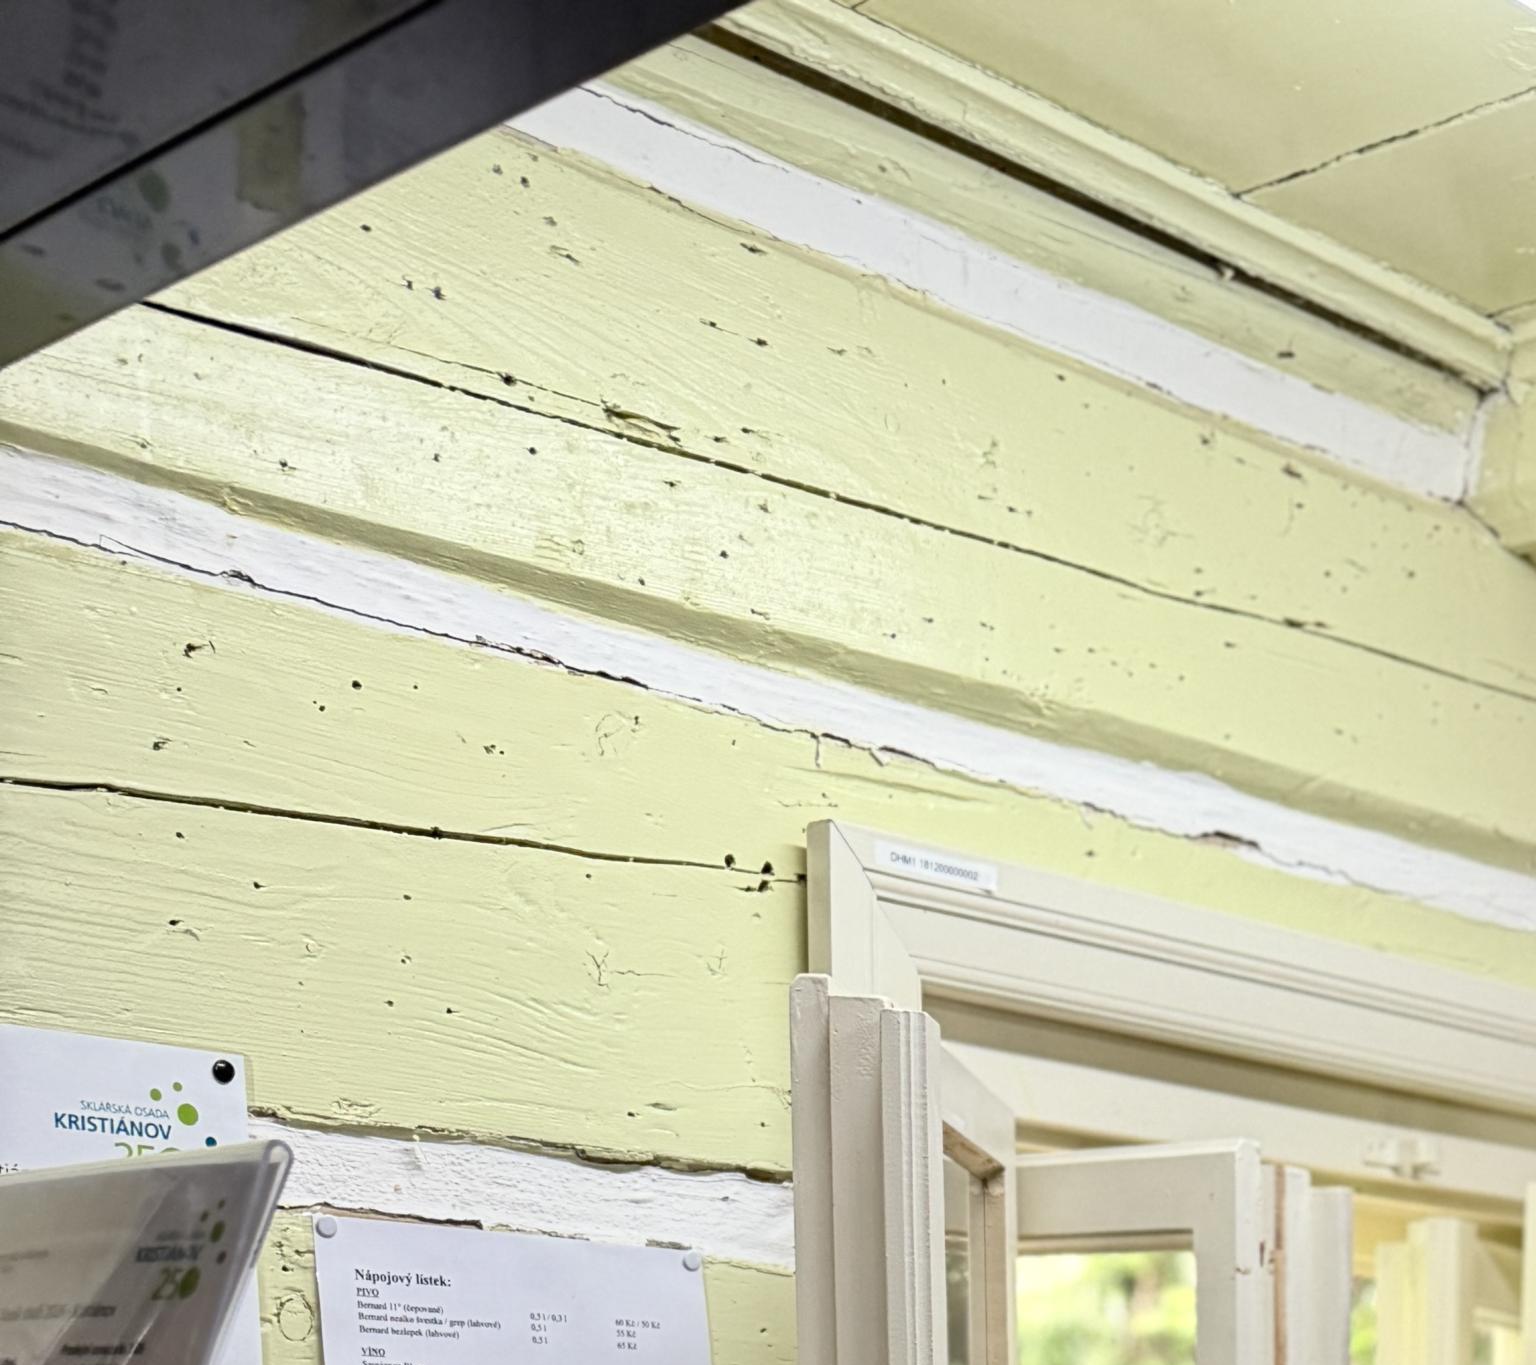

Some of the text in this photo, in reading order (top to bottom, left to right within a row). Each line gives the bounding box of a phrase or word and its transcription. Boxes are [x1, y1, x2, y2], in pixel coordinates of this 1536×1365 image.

[134, 1106, 169, 1119] OSADA
[54, 1112, 172, 1140] KRISTIÁNOV
[355, 1269, 451, 1287] Nápojový lístek:
[357, 1288, 379, 1297] PIVO
[358, 1301, 387, 1310] Bernard
[358, 1312, 387, 1322] Bernard
[359, 1325, 389, 1335] Bernard
[361, 1346, 385, 1357] VÍNO
